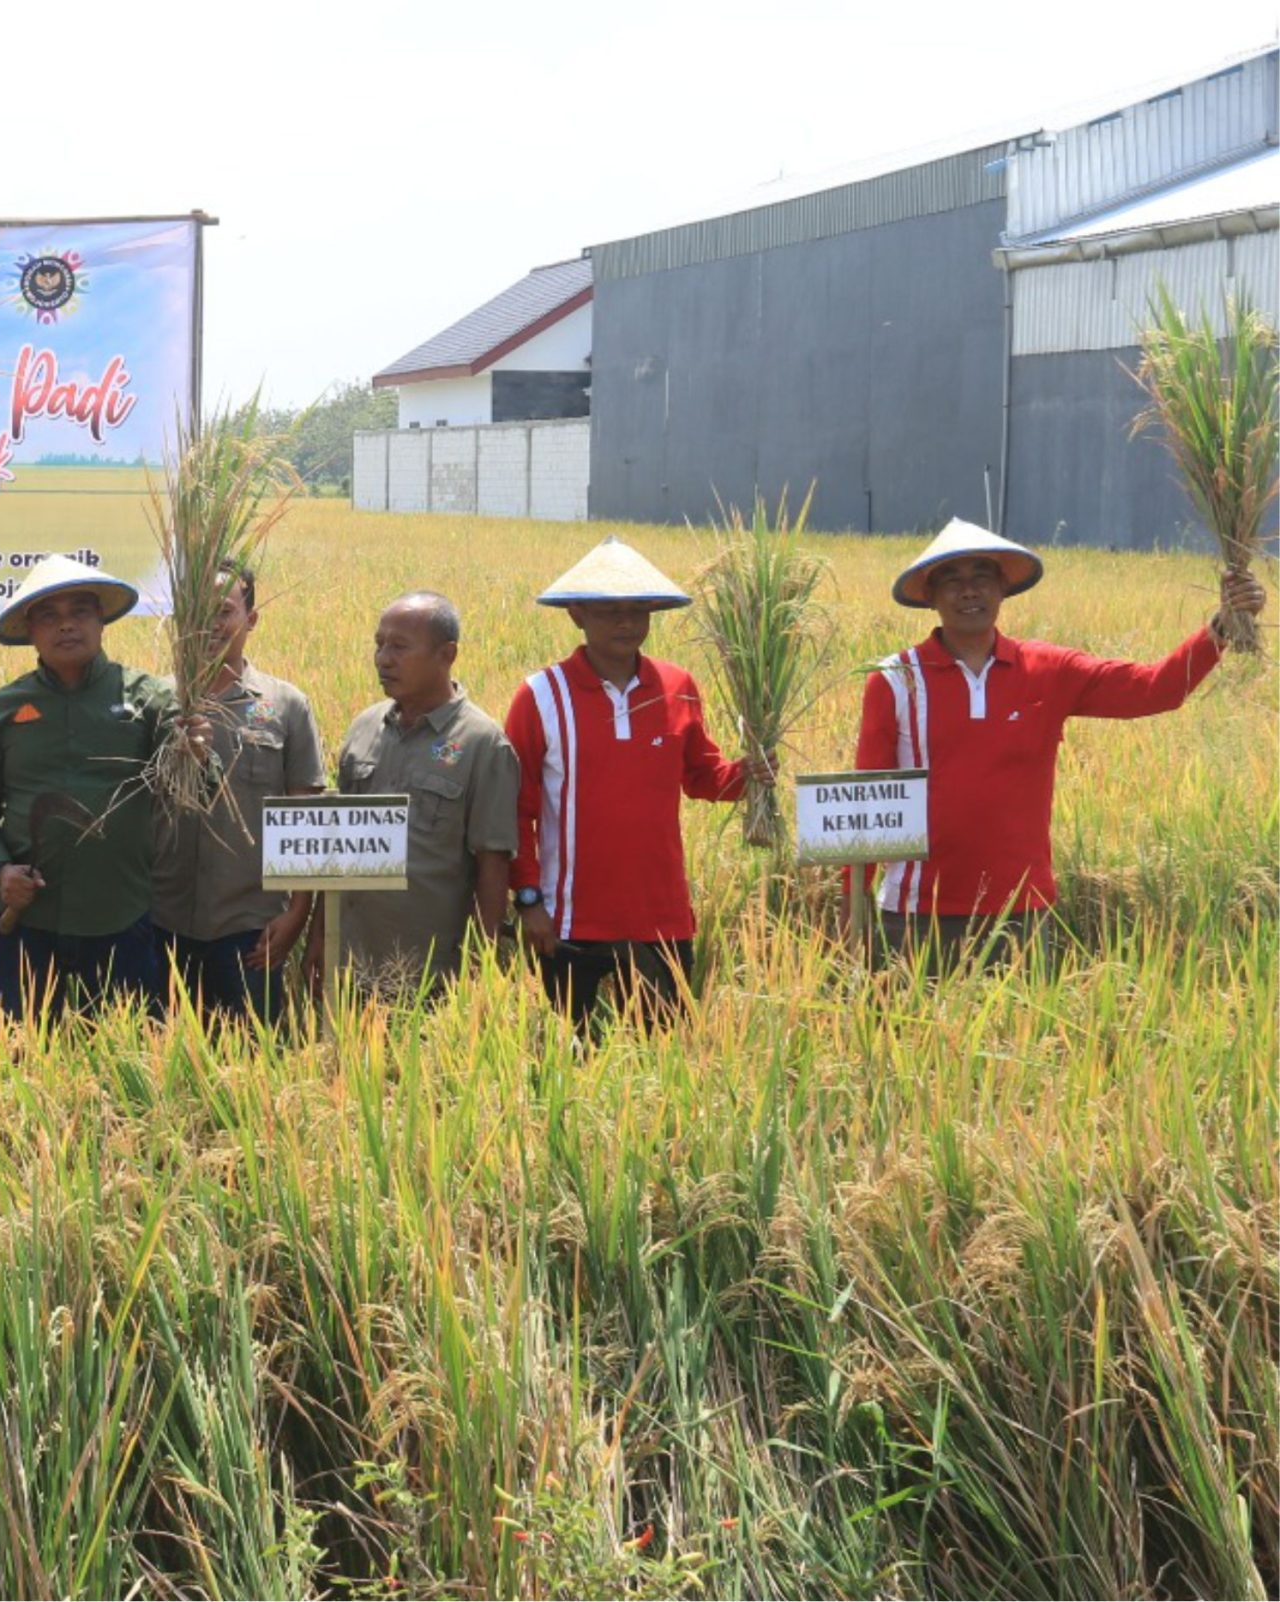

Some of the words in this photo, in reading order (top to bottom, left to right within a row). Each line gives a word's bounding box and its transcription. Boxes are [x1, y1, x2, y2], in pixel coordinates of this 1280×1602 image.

[12, 346, 134, 441] Padi
[816, 783, 910, 804] DANRAMIL
[265, 810, 340, 827] KEPALA
[348, 809, 407, 826] DINAS
[823, 811, 903, 832] KEMLAGI
[280, 838, 391, 856] PERTANIAN
